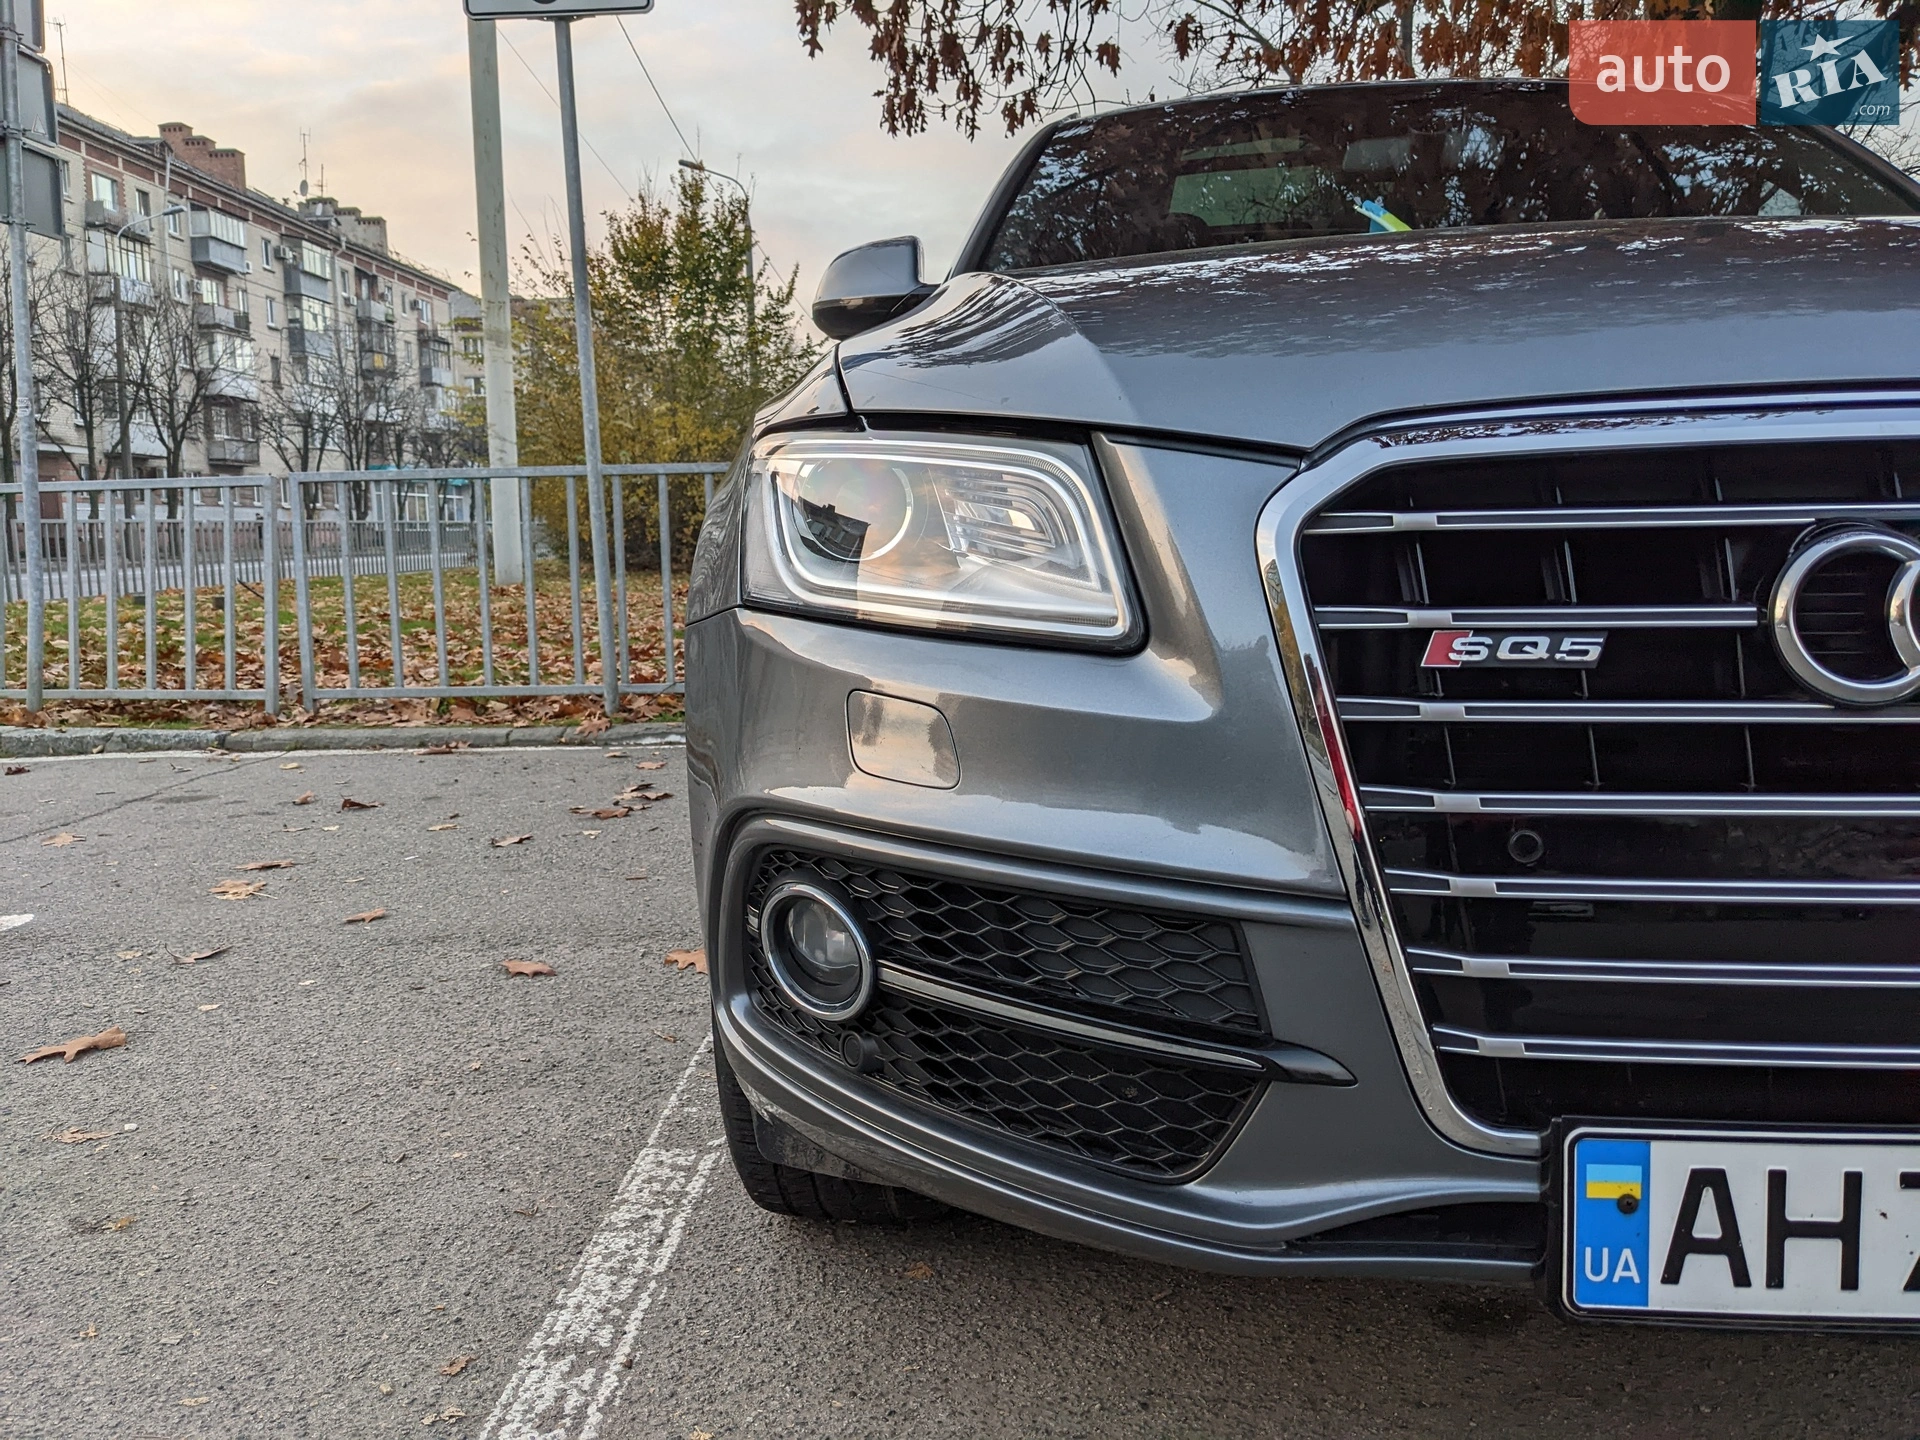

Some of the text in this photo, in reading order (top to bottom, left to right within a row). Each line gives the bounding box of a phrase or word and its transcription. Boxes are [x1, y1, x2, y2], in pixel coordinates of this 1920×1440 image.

[1448, 636, 1604, 662] SQ5
[1660, 1167, 1864, 1291] AH
[1584, 1247, 1641, 1284] UA
